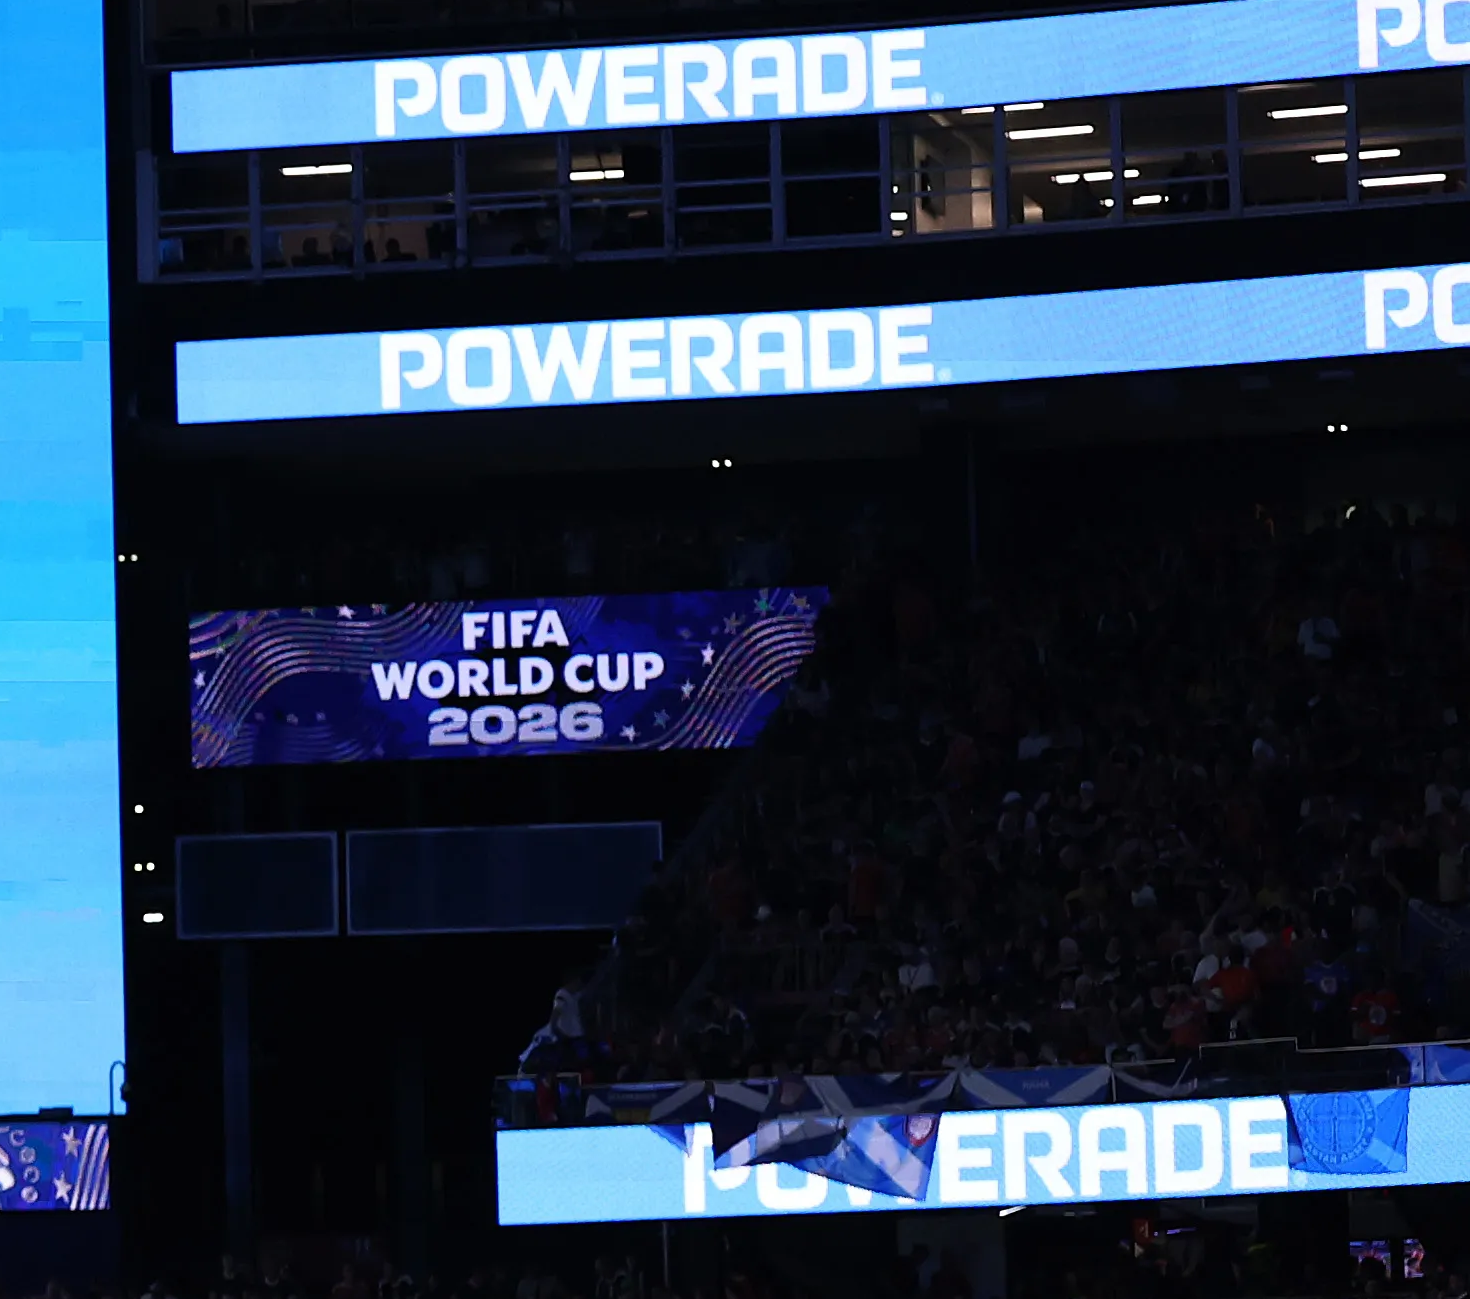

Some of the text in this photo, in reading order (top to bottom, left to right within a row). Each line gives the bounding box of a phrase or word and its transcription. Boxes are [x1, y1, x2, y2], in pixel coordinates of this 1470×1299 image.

[375, 29, 929, 138] POWERADE
[380, 305, 937, 411] POWERADE
[463, 609, 568, 651] FIFA
[371, 652, 664, 701] WORLD CUP
[428, 703, 603, 745] 2026
